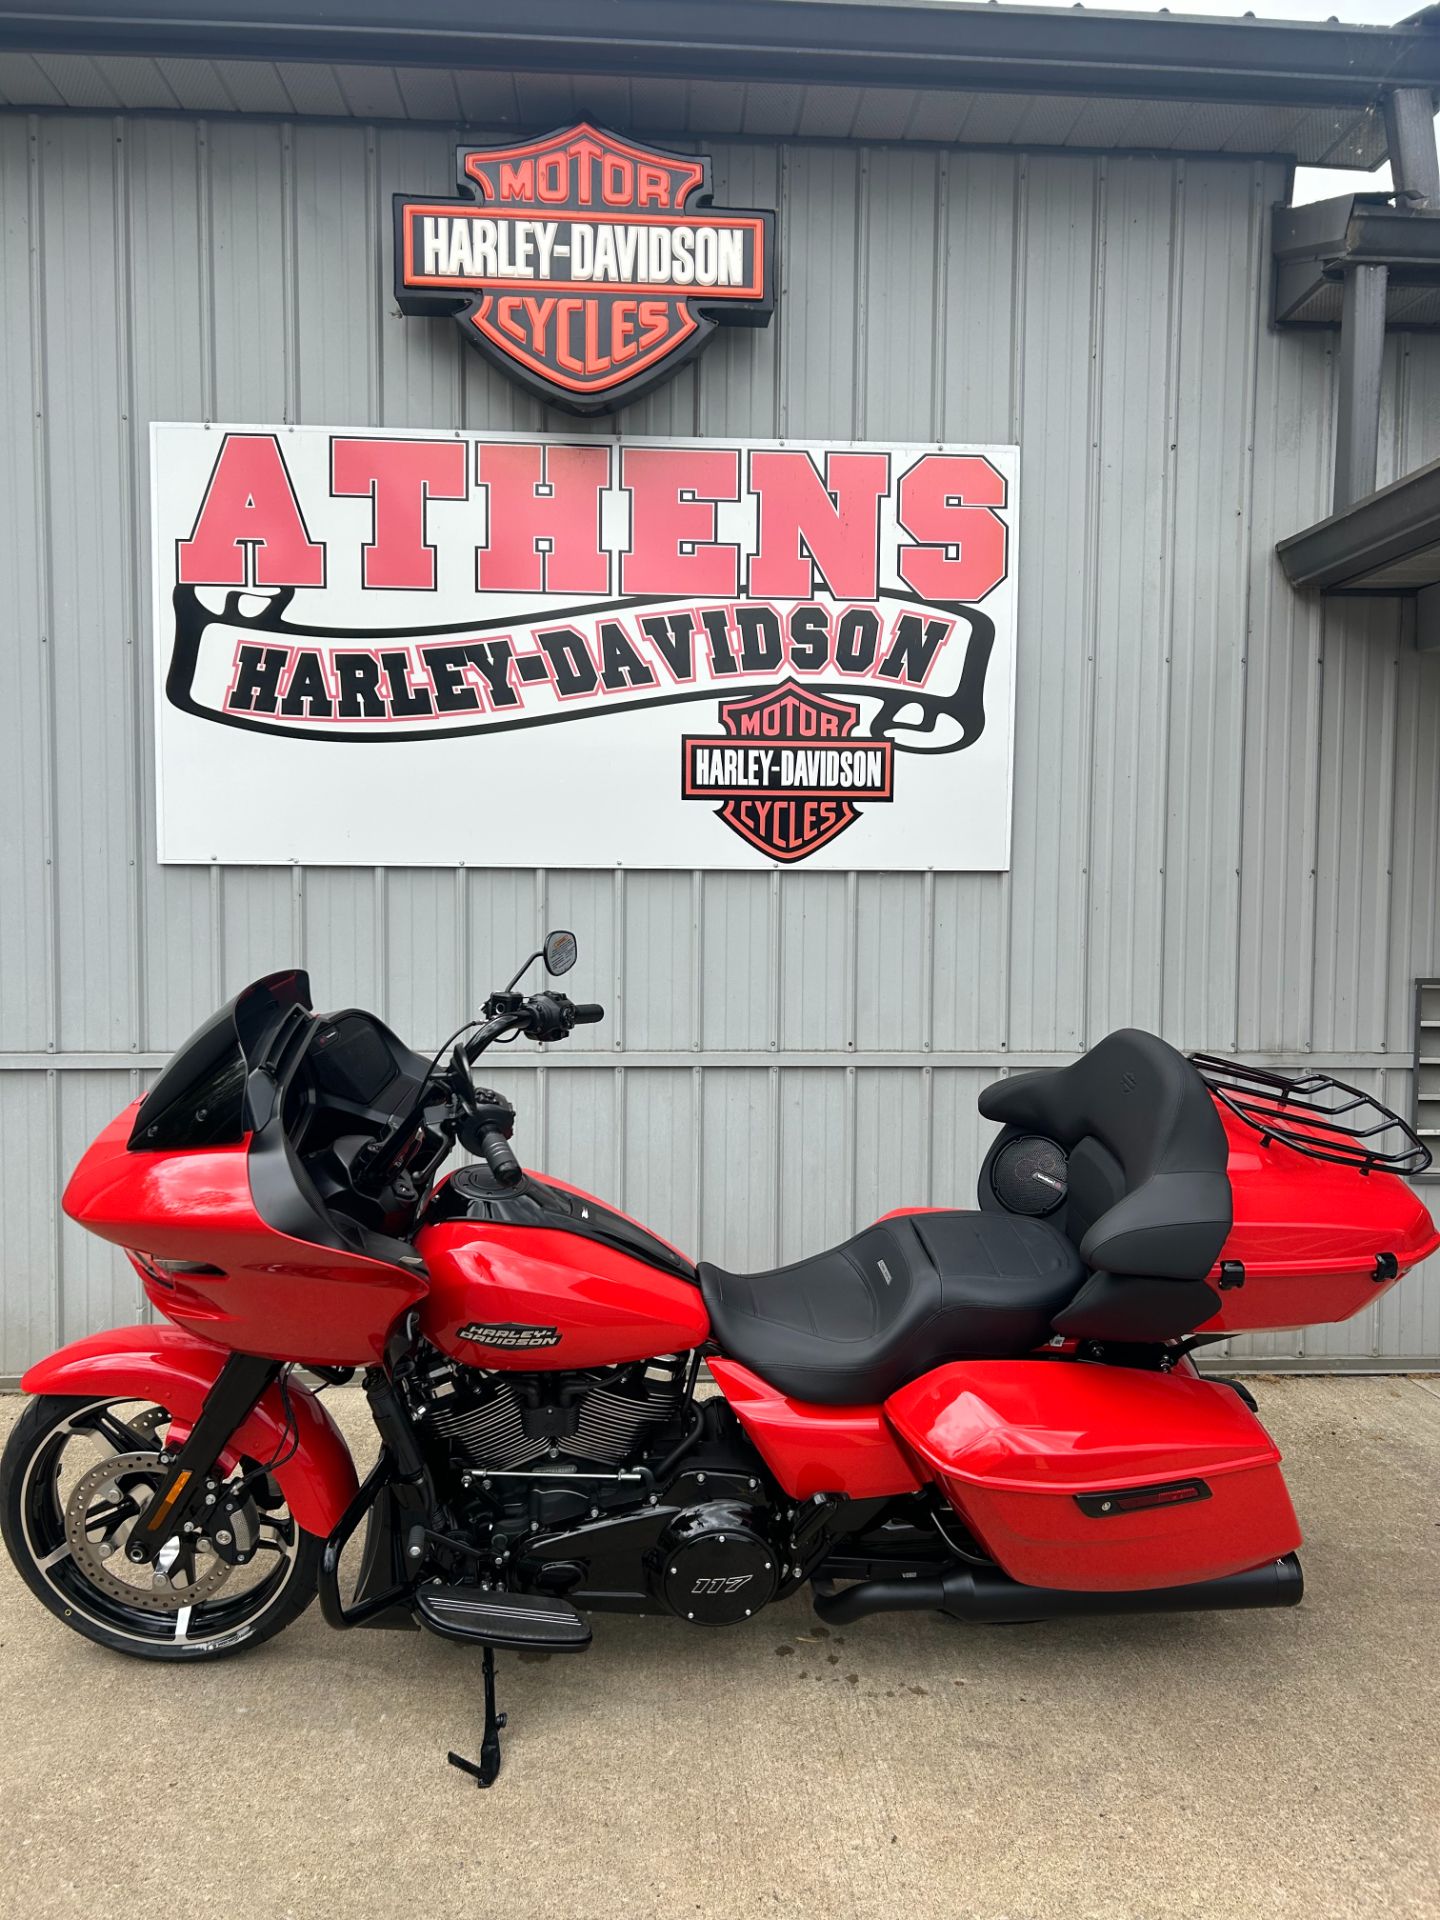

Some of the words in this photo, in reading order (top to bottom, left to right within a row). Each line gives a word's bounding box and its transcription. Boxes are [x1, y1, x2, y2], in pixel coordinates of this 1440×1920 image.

[500, 138, 671, 208] MOTOR
[423, 216, 744, 286] HARLEY-DAVIDSON
[497, 296, 669, 375] CYCLES
[175, 433, 1008, 604] ATHENS
[222, 602, 957, 722] HARLEY-DAVIDSON
[741, 695, 839, 737] MOTOR
[696, 748, 882, 788] HARLEY-DAVIDSON
[740, 800, 836, 848] CYCLES
[460, 1331, 557, 1346] DAVIDSON
[470, 1326, 552, 1339] HARLEY-
[691, 1574, 754, 1593] 117
